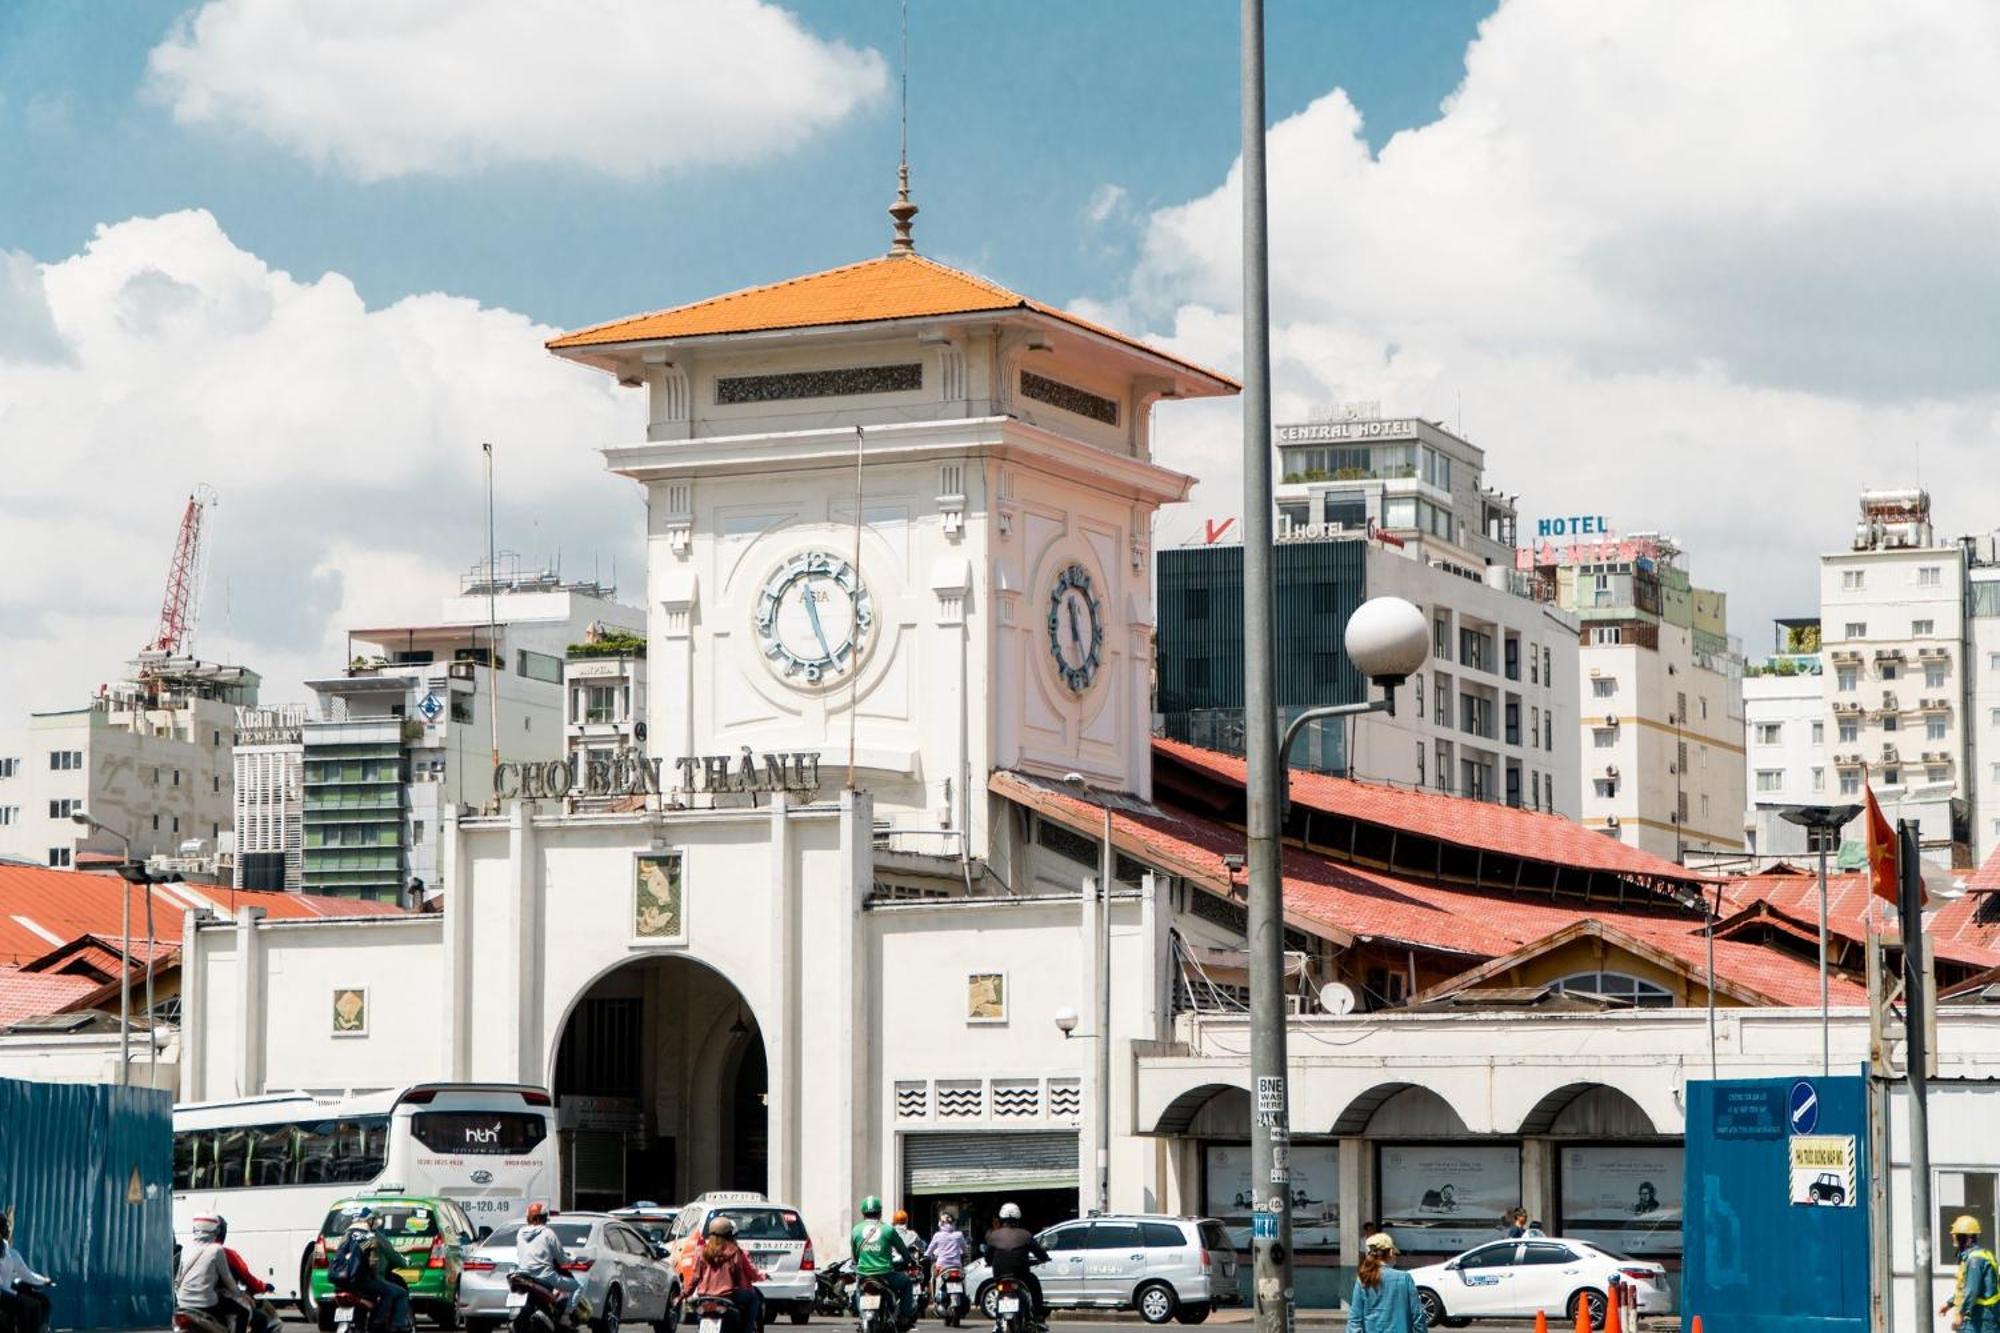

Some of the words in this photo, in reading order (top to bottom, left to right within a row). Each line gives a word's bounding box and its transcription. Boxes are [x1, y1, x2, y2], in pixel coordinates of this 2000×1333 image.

[1279, 424, 1350, 440] CENTRAL
[1358, 420, 1410, 436] HOTEL
[1295, 521, 1344, 538] HOTEL
[1538, 515, 1608, 536] HOTEL
[240, 731, 300, 743] JEWELRY
[1260, 1079, 1282, 1092] BNE
[1260, 1101, 1282, 1109] HERE
